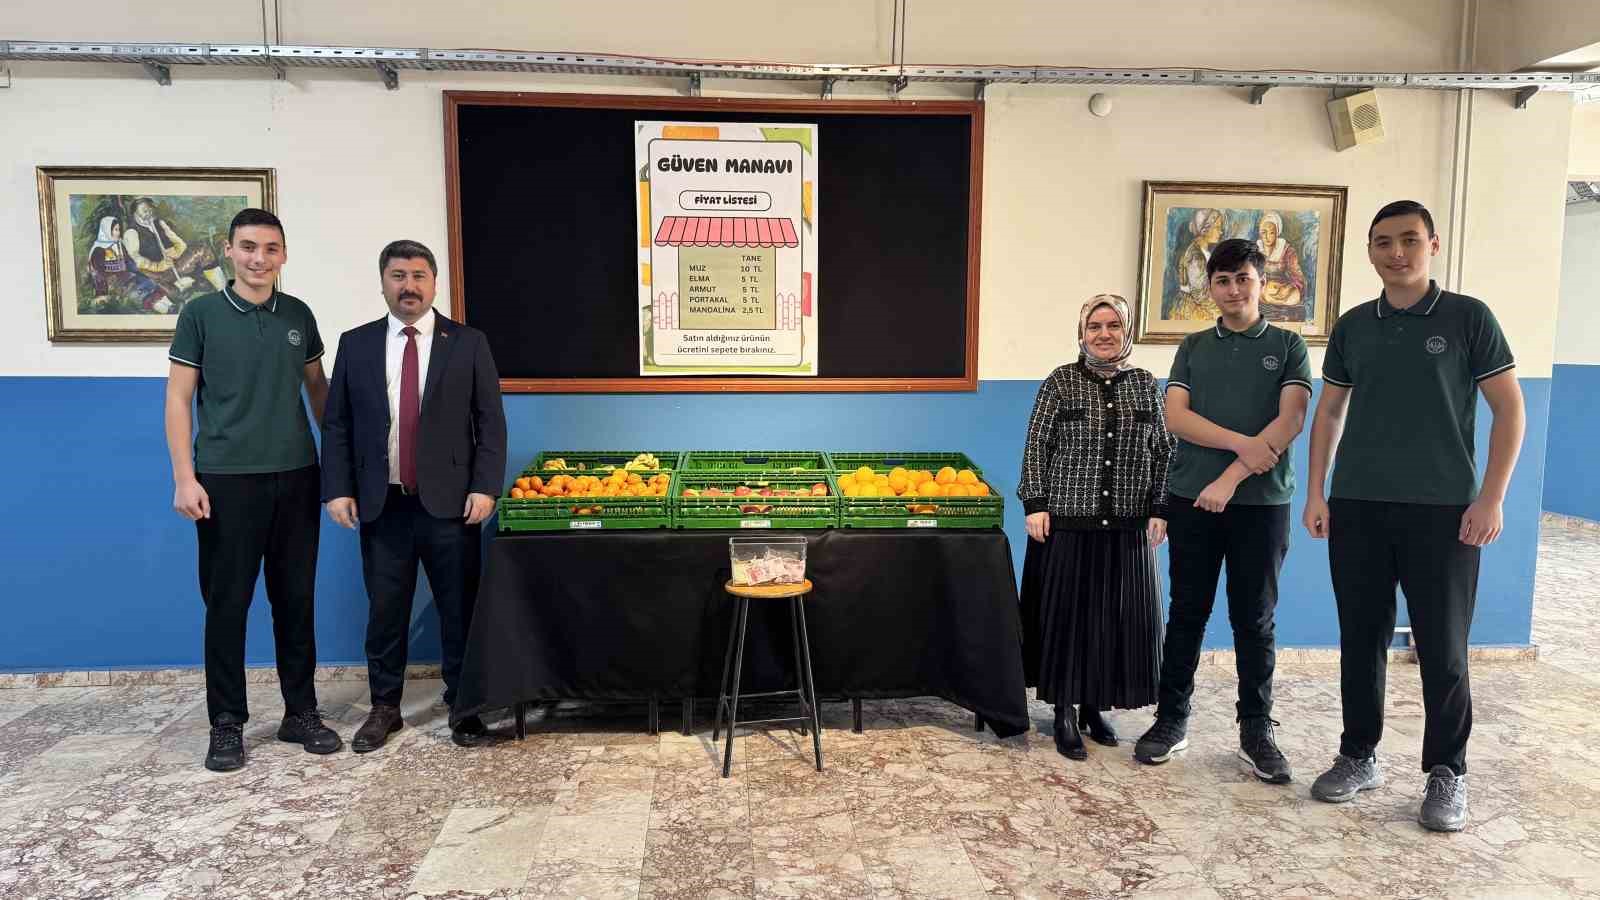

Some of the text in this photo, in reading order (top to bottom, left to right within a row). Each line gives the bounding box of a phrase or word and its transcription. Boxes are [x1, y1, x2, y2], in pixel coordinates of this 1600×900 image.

[657, 155, 793, 173] GÜVEN MANAVI
[694, 194, 757, 205] FİYAT LİSTESİ
[683, 334, 704, 342] Satın
[706, 334, 739, 343] aldığınız
[710, 347, 738, 355] sepete
